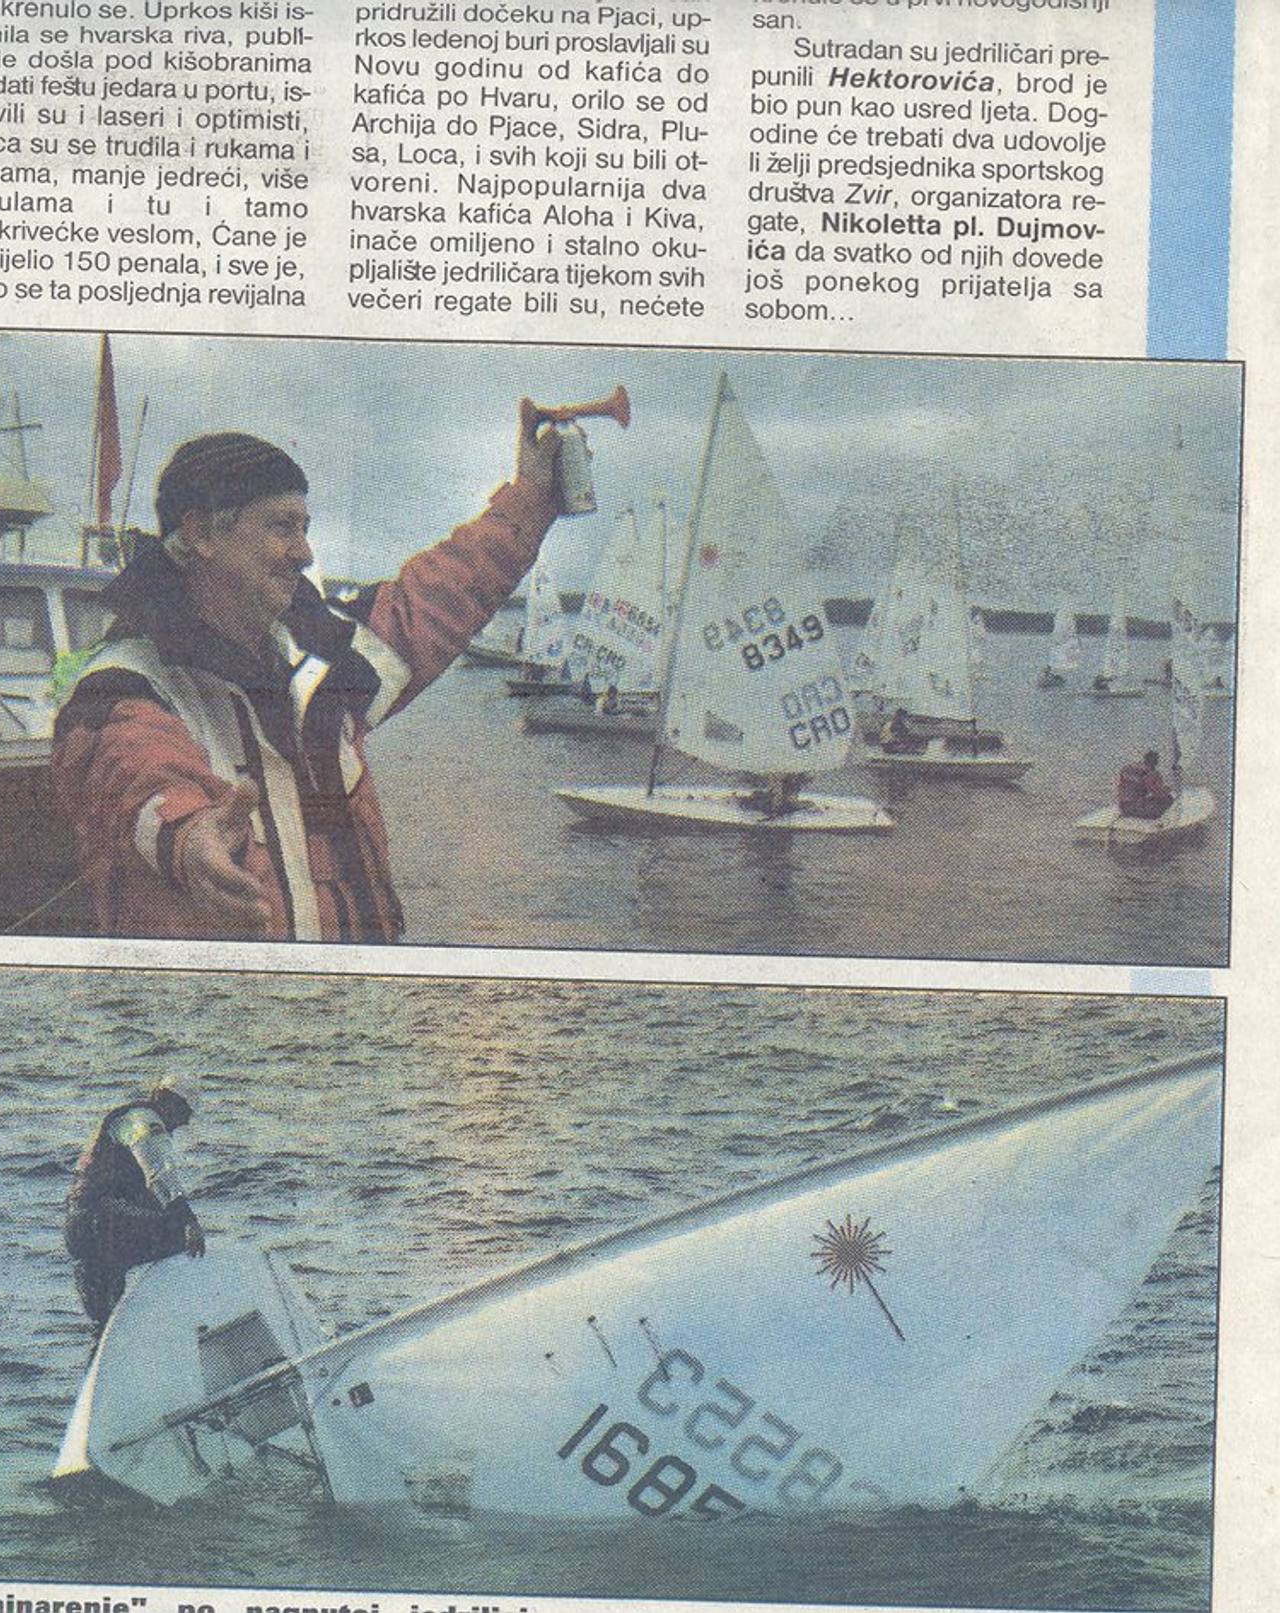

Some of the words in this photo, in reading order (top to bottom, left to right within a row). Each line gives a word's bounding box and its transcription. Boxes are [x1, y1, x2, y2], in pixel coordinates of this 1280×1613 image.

[355, 2, 456, 25] pridružili
[462, 3, 554, 24] dočeku
[561, 9, 591, 25] na
[596, 6, 663, 30] Pjaci,
[672, 12, 712, 32] up-
[752, 13, 802, 30] san.
[39, 29, 69, 44] se
[80, 25, 174, 44] hvarska
[184, 25, 233, 48] riva,
[355, 27, 407, 48] rkos
[412, 28, 499, 54] ledenoj
[505, 30, 550, 51] buri
[555, 32, 676, 58] proslavljali
[681, 39, 710, 56] su
[793, 36, 903, 61] Sutradan
[909, 44, 938, 62] su
[943, 40, 1053, 66] jedriličari
[1060, 48, 1110, 69] pre-
[28, 50, 94, 70] došla
[105, 50, 153, 73] pod
[164, 50, 313, 74] kišobranima
[354, 53, 420, 77] Novu
[434, 56, 523, 82] godinu
[537, 59, 570, 81] od
[585, 59, 662, 84] kafića
[676, 62, 710, 85] do
[40, 74, 96, 97] feštu
[100, 76, 178, 101] jedara
[183, 83, 198, 100] u
[204, 80, 275, 105] portu,
[283, 80, 312, 103] is-
[353, 82, 426, 106] kafića
[437, 89, 469, 111] po
[480, 85, 558, 113] Hvaru,
[571, 88, 625, 111] orilo
[635, 95, 666, 113] se
[677, 91, 709, 114] od
[751, 65, 814, 90] punili
[828, 66, 1002, 96] Hektorovića,
[1016, 71, 1074, 95] brod
[1084, 73, 1108, 99] je
[37, 107, 67, 125] su
[79, 104, 85, 125] i
[97, 104, 164, 128] laseri
[177, 106, 183, 128] i
[195, 108, 308, 135] optimisti,
[750, 93, 788, 116] bio
[796, 99, 842, 120] pun
[850, 95, 895, 118] kao
[903, 99, 972, 121] usred
[981, 99, 1038, 125] ljeta.
[1048, 101, 1109, 129] Dog-
[351, 111, 437, 139] Archija
[446, 114, 478, 137] do
[489, 114, 565, 142] Pjace,
[577, 117, 648, 144] Sidra,
[661, 119, 709, 143] Plu-
[749, 122, 819, 146] odine
[827, 123, 858, 147] će
[865, 125, 944, 149] trebati
[952, 127, 995, 150] dva
[1003, 130, 1107, 157] udovolje
[71, 164, 146, 190] manje
[155, 164, 249, 192] jedreći,
[260, 167, 309, 190] više
[749, 151, 760, 173] li
[766, 151, 811, 179] želji
[817, 154, 976, 181] predsjednika
[981, 159, 1104, 187] sportskog
[350, 171, 438, 194] voreni.
[457, 172, 646, 203] Najpopularnija
[661, 178, 707, 201] dva
[747, 180, 835, 205] društva
[844, 182, 899, 209] Zvir,
[910, 186, 1063, 212] organizatora
[1072, 194, 1107, 212] re-
[107, 192, 113, 215] i
[146, 195, 171, 217] tu
[205, 195, 211, 217] i
[244, 197, 309, 219] tamo
[350, 199, 447, 224] hvarska
[458, 201, 533, 225] kafića
[542, 203, 615, 228] Aloha
[626, 206, 632, 227] i
[645, 206, 704, 233] Kiva,
[107, 223, 201, 249] veslom,
[211, 219, 277, 248] Ćane
[283, 225, 307, 252] je
[350, 228, 418, 252] inače
[429, 231, 536, 258] omiljeno
[547, 233, 553, 255] i
[564, 234, 640, 258] stalno
[651, 236, 707, 259] oku-
[747, 211, 806, 236] gate,
[821, 211, 942, 236] Nikoletta
[953, 215, 985, 241] pl.
[996, 216, 1106, 244] Dujmov-
[63, 250, 111, 273] 150
[117, 252, 207, 279] penala,
[216, 253, 222, 275] i
[227, 257, 269, 277] sve
[273, 255, 304, 281] je,
[747, 238, 786, 261] ića
[795, 239, 826, 263] da
[833, 242, 913, 265] svatko
[920, 243, 952, 266] od
[961, 244, 1003, 271] njih
[1012, 246, 1104, 270] dovede
[349, 258, 437, 284] pljalište
[441, 260, 560, 286] jedriličara
[565, 262, 652, 289] tijekom
[658, 266, 705, 288] svih
[743, 268, 784, 294] još
[805, 271, 920, 299] ponekog
[941, 274, 1052, 302] prijatelja
[1073, 281, 1104, 299] sa
[14, 282, 44, 300] se
[48, 279, 72, 301] ta
[78, 280, 202, 308] posljednja
[208, 283, 306, 310] revijalna
[347, 287, 422, 311] večeri
[434, 291, 512, 317] regate
[524, 291, 558, 314] bili
[569, 297, 606, 319] su,
[619, 294, 705, 318] nećete
[741, 614, 824, 671] 8349
[789, 706, 852, 749] CRO
